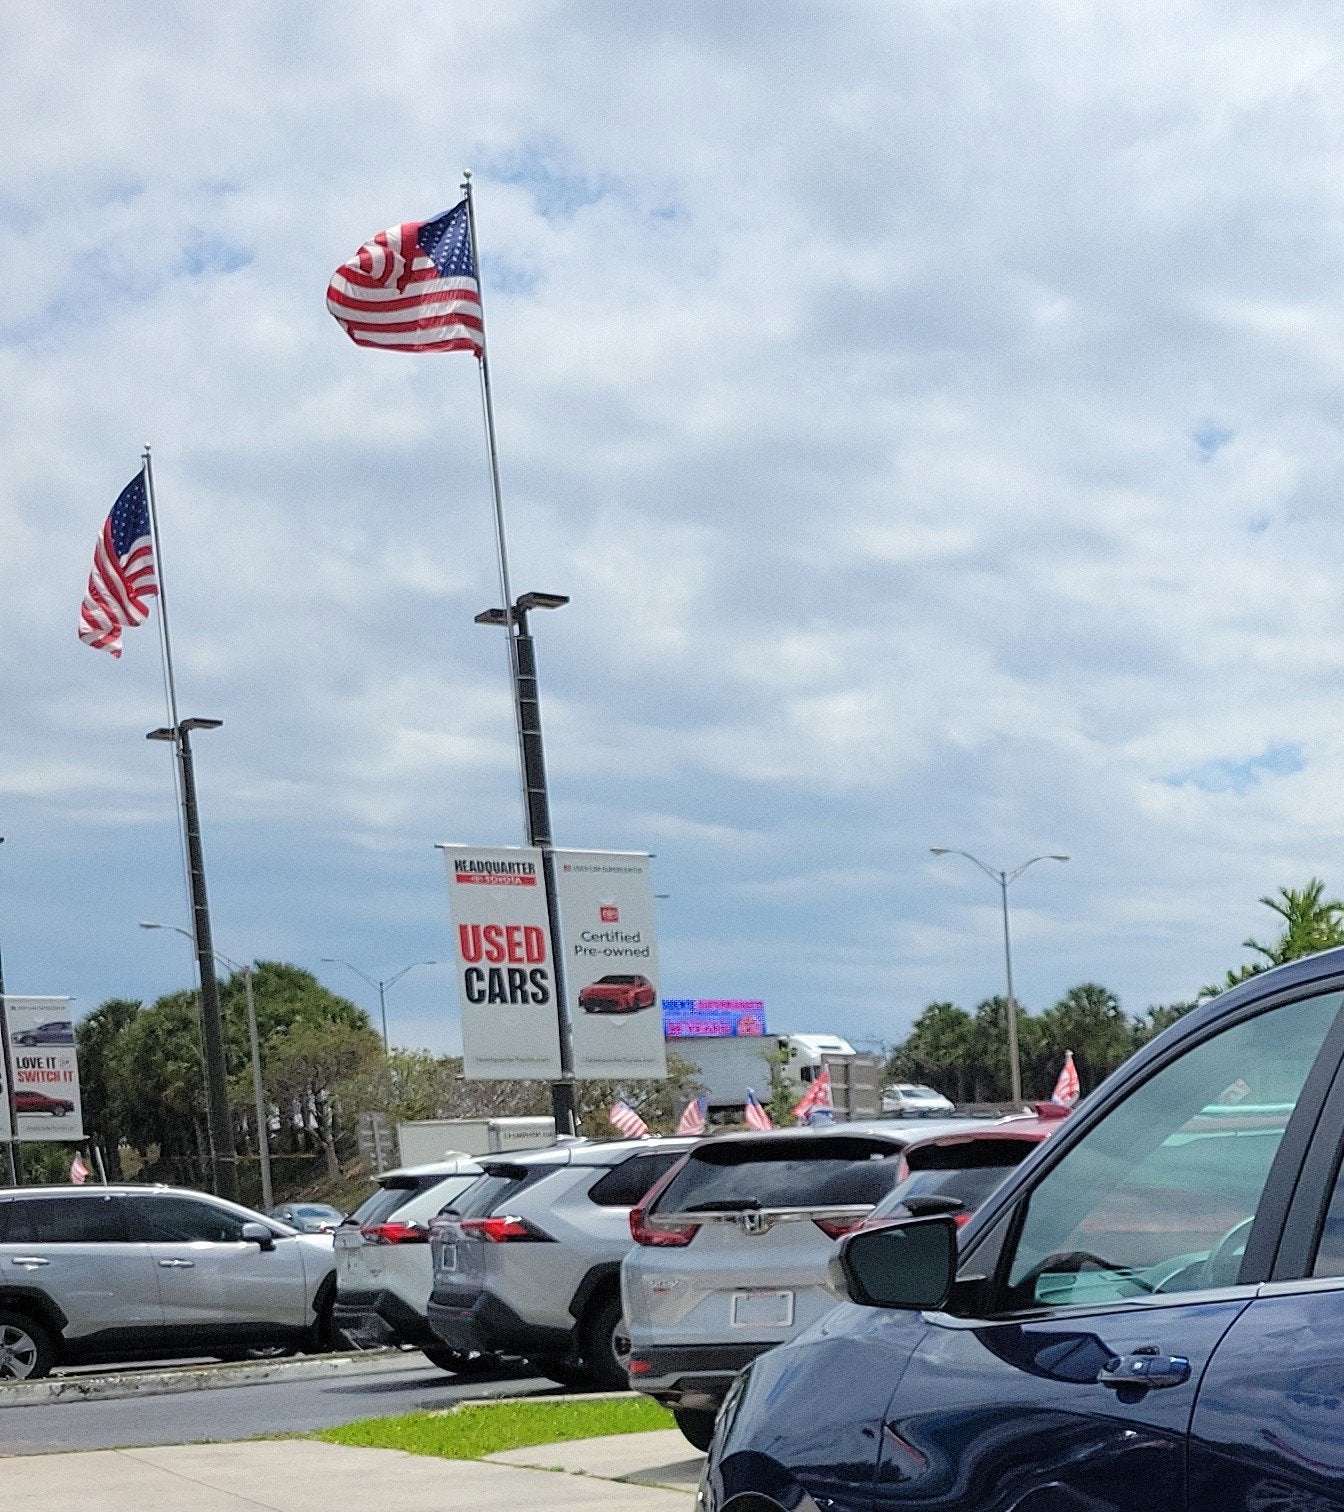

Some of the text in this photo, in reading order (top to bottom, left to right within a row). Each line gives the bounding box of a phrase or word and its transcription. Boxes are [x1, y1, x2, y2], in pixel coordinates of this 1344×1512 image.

[454, 859, 536, 875] HEADQUARTER
[458, 923, 547, 965] USED
[581, 930, 641, 944] Certified
[574, 945, 650, 958] Pre-owned
[464, 966, 550, 1006] CARS
[16, 1056, 43, 1069] LOVE
[46, 1056, 57, 1069] IT
[17, 1070, 74, 1083] SWITCH IT
